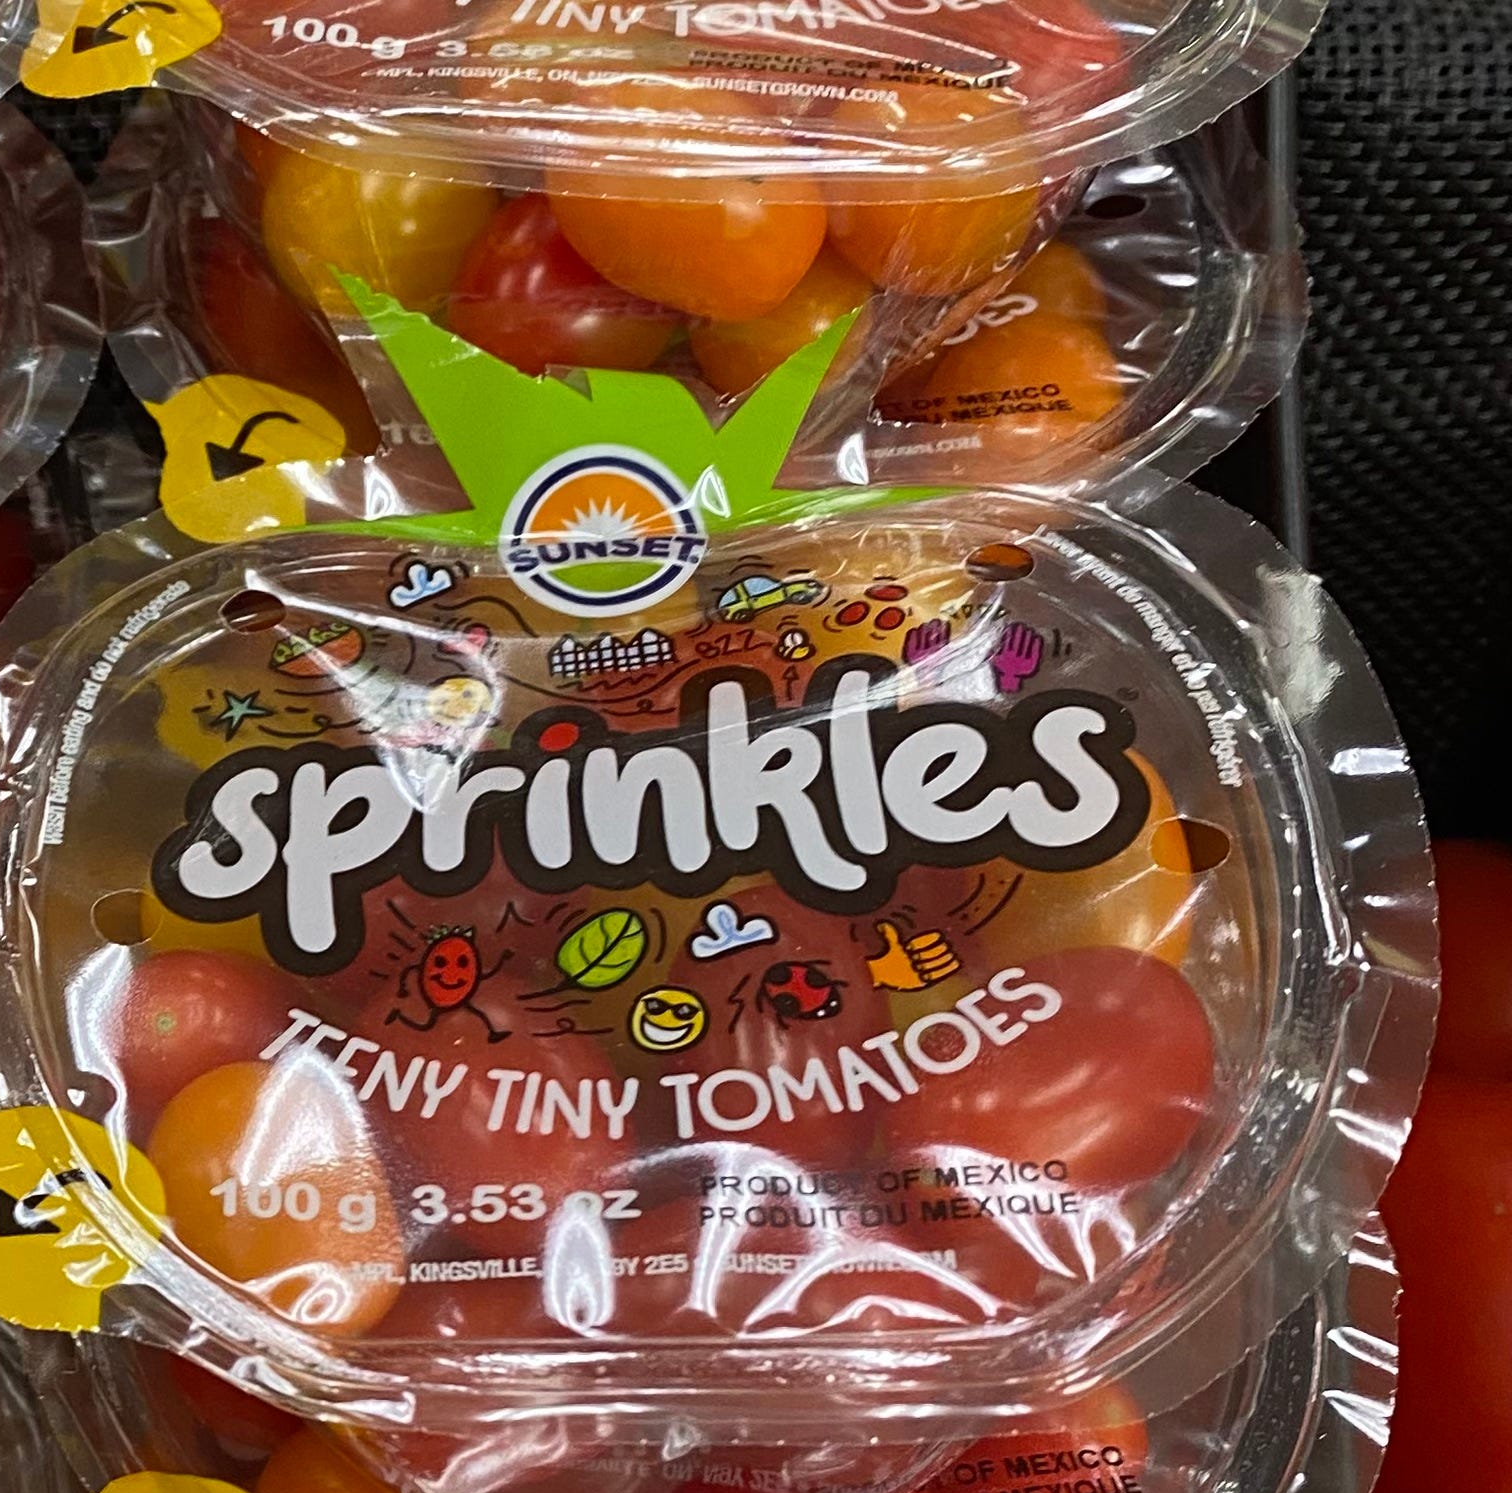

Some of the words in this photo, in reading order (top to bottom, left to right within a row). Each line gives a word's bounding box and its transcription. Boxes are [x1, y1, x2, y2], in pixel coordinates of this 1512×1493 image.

[262, 15, 359, 48] 100
[509, 535, 707, 574] SUNSET
[178, 669, 1119, 953] sprinkles
[486, 1067, 640, 1141] TINY
[659, 966, 1066, 1140] TOMATOES
[882, 1171, 920, 1194] OF
[934, 1159, 1069, 1187] MEXICO
[209, 1177, 321, 1219] 100
[338, 1192, 377, 1235] g
[410, 1183, 547, 1225] 3.53
[699, 1203, 850, 1229] PRODUIT
[864, 1202, 908, 1228] DU
[954, 1460, 995, 1485] OF
[1003, 1445, 1126, 1477] MEXICO
